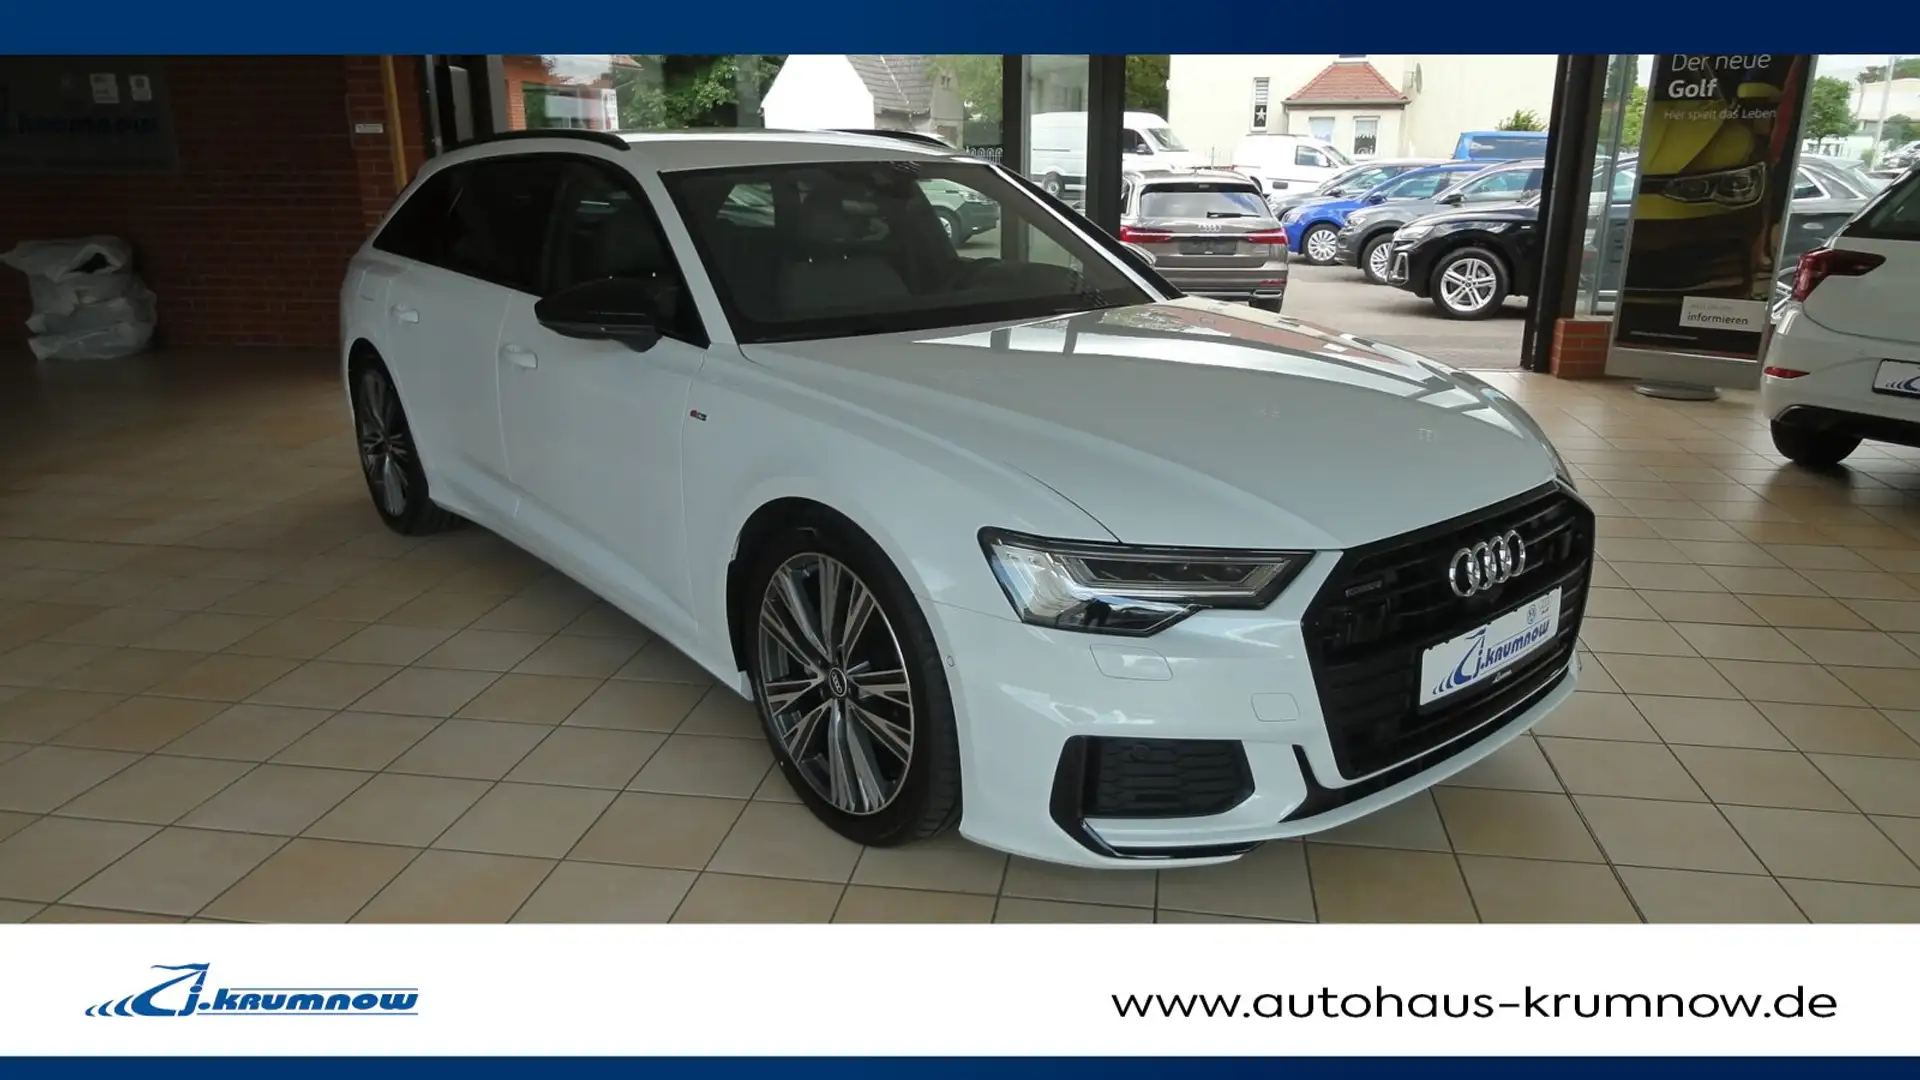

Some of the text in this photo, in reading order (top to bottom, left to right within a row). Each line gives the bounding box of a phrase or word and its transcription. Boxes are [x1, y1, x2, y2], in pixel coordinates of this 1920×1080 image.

[1671, 53, 1772, 72] Der neue
[1668, 78, 1718, 98] Golf
[1664, 107, 1777, 122] Hier spielt das Leben
[1687, 312, 1749, 325] informieren
